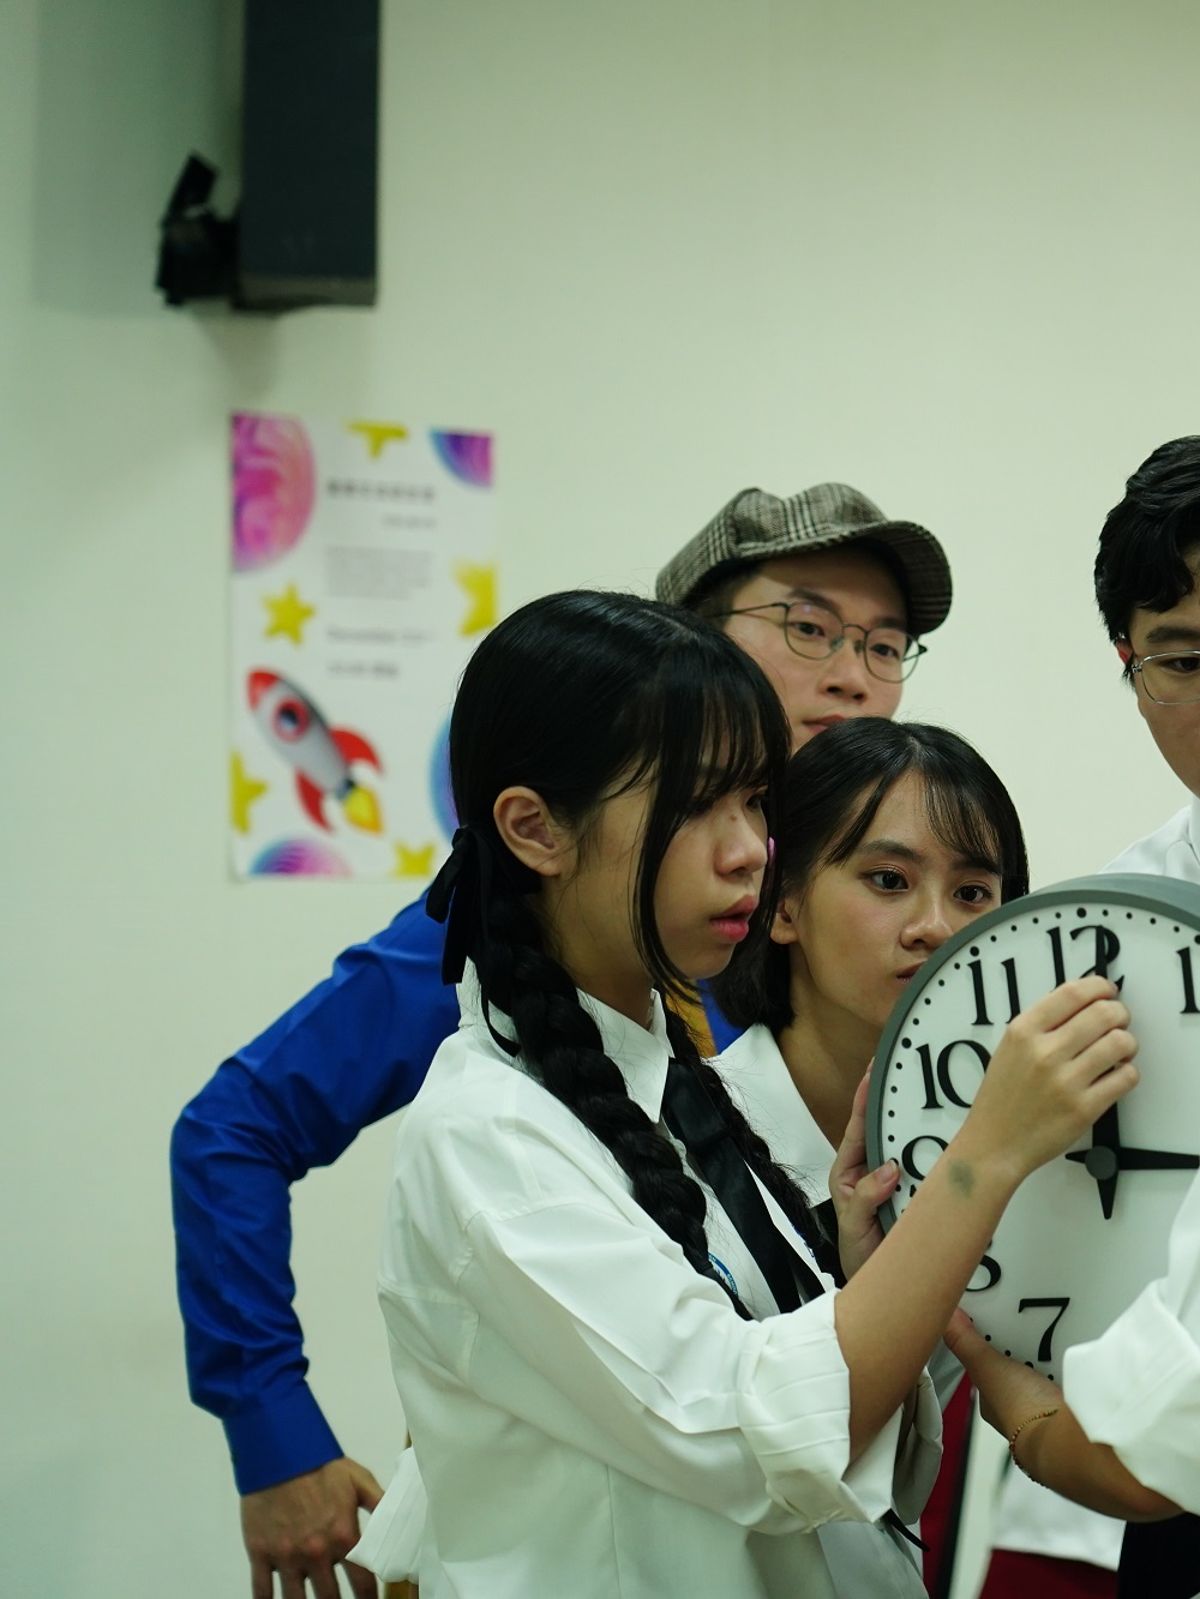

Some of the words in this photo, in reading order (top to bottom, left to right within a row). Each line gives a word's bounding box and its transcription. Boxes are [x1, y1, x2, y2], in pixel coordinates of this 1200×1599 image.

[967, 957, 1021, 1026] 11
[1046, 925, 1125, 991] 12
[915, 1039, 992, 1110] 10
[1018, 1297, 1071, 1362] 7
